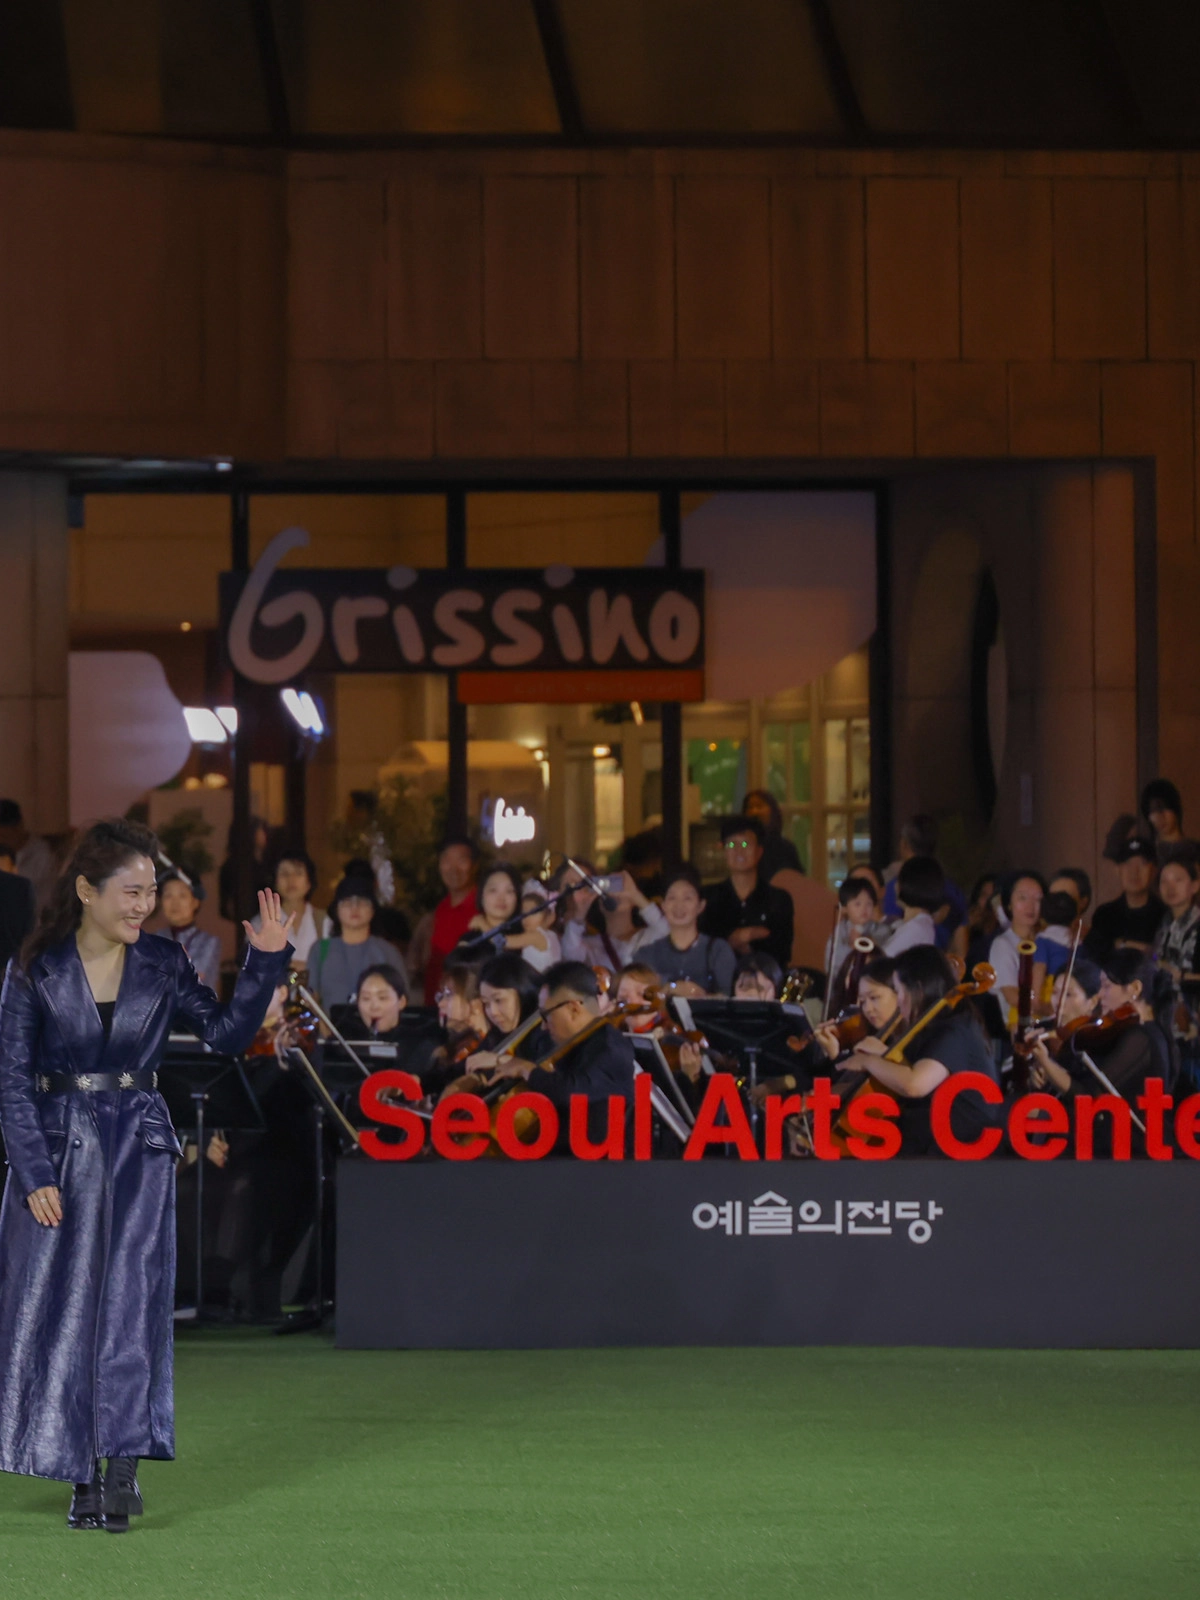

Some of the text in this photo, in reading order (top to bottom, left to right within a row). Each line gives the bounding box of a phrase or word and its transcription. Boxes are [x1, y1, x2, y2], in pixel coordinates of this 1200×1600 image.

[357, 1069, 652, 1161] Seoul
[682, 1072, 902, 1161] Arts
[692, 1190, 943, 1244] 예술의전당
